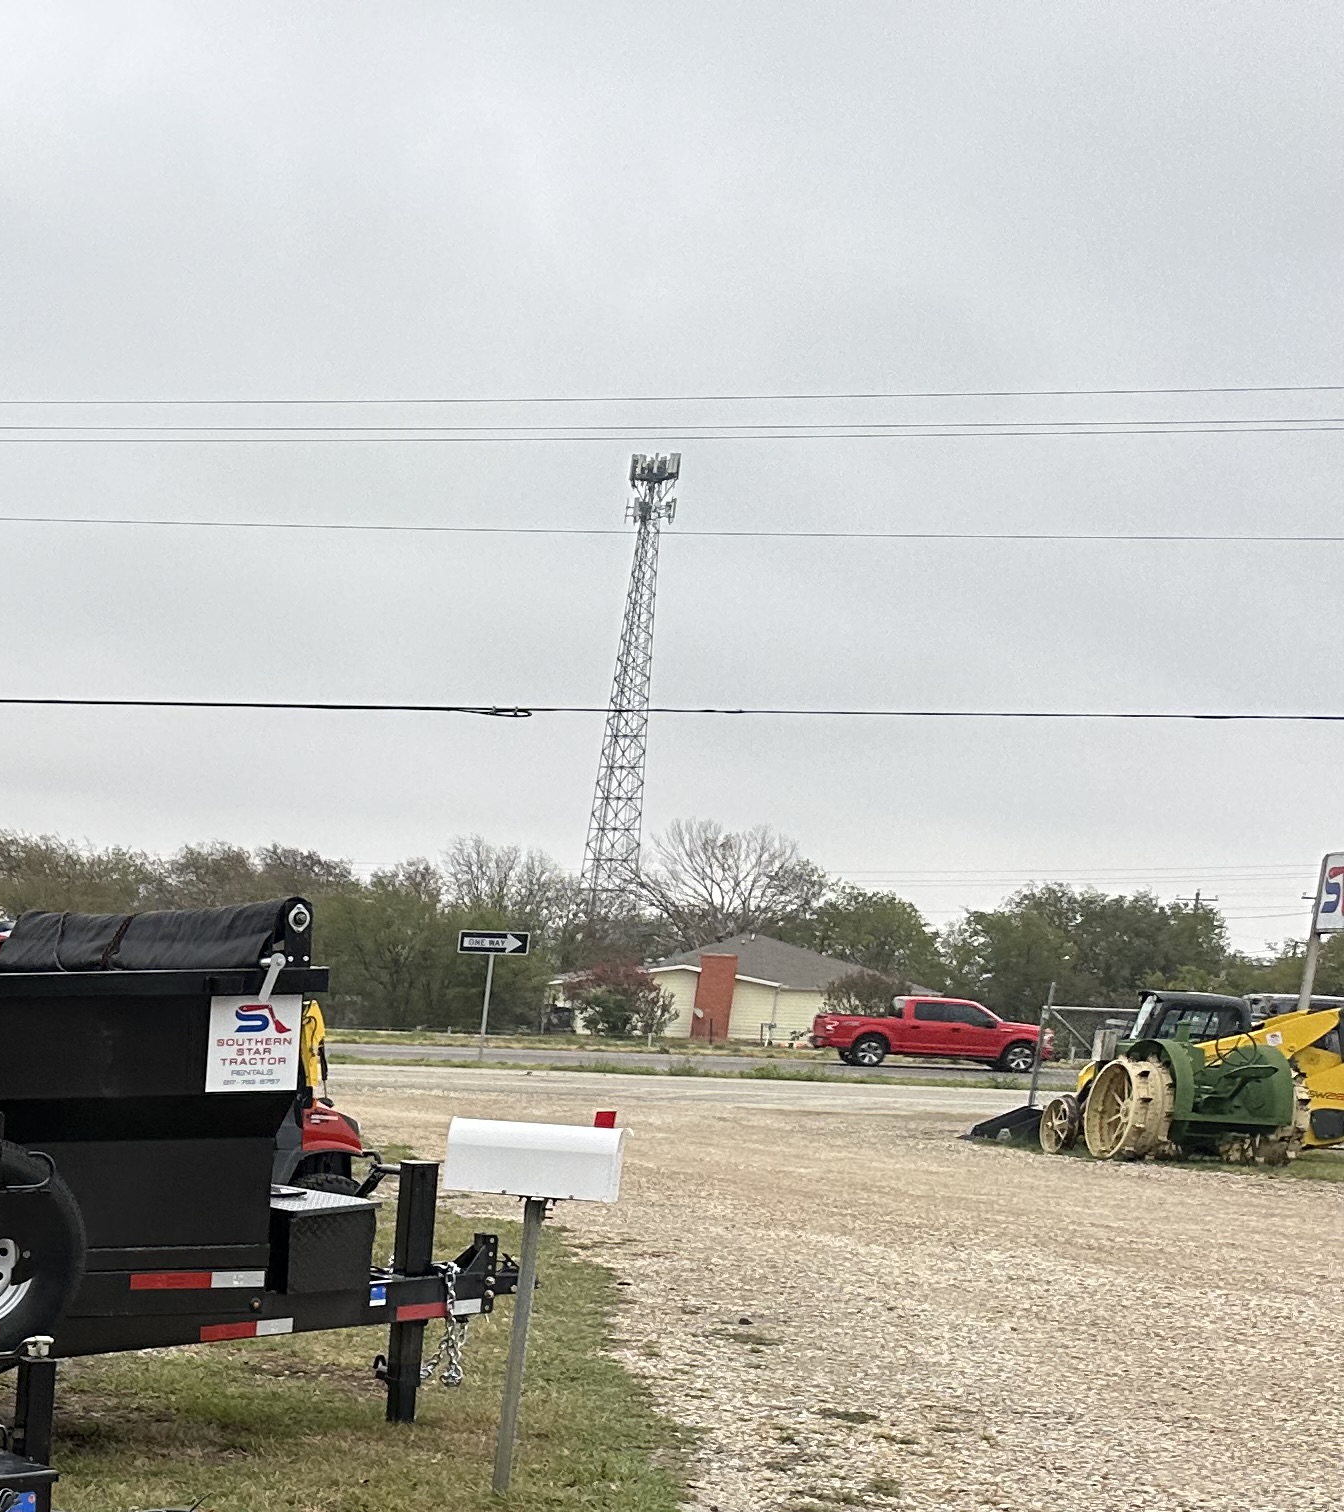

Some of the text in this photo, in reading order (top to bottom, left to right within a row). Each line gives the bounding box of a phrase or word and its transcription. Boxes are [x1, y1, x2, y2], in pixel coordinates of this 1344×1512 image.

[468, 938, 506, 947] ONE WAY
[216, 1037, 292, 1047] SOUTHERN
[235, 1047, 272, 1056] STAR
[219, 1057, 287, 1067] TRACTOR
[230, 1069, 274, 1077] RENTALS
